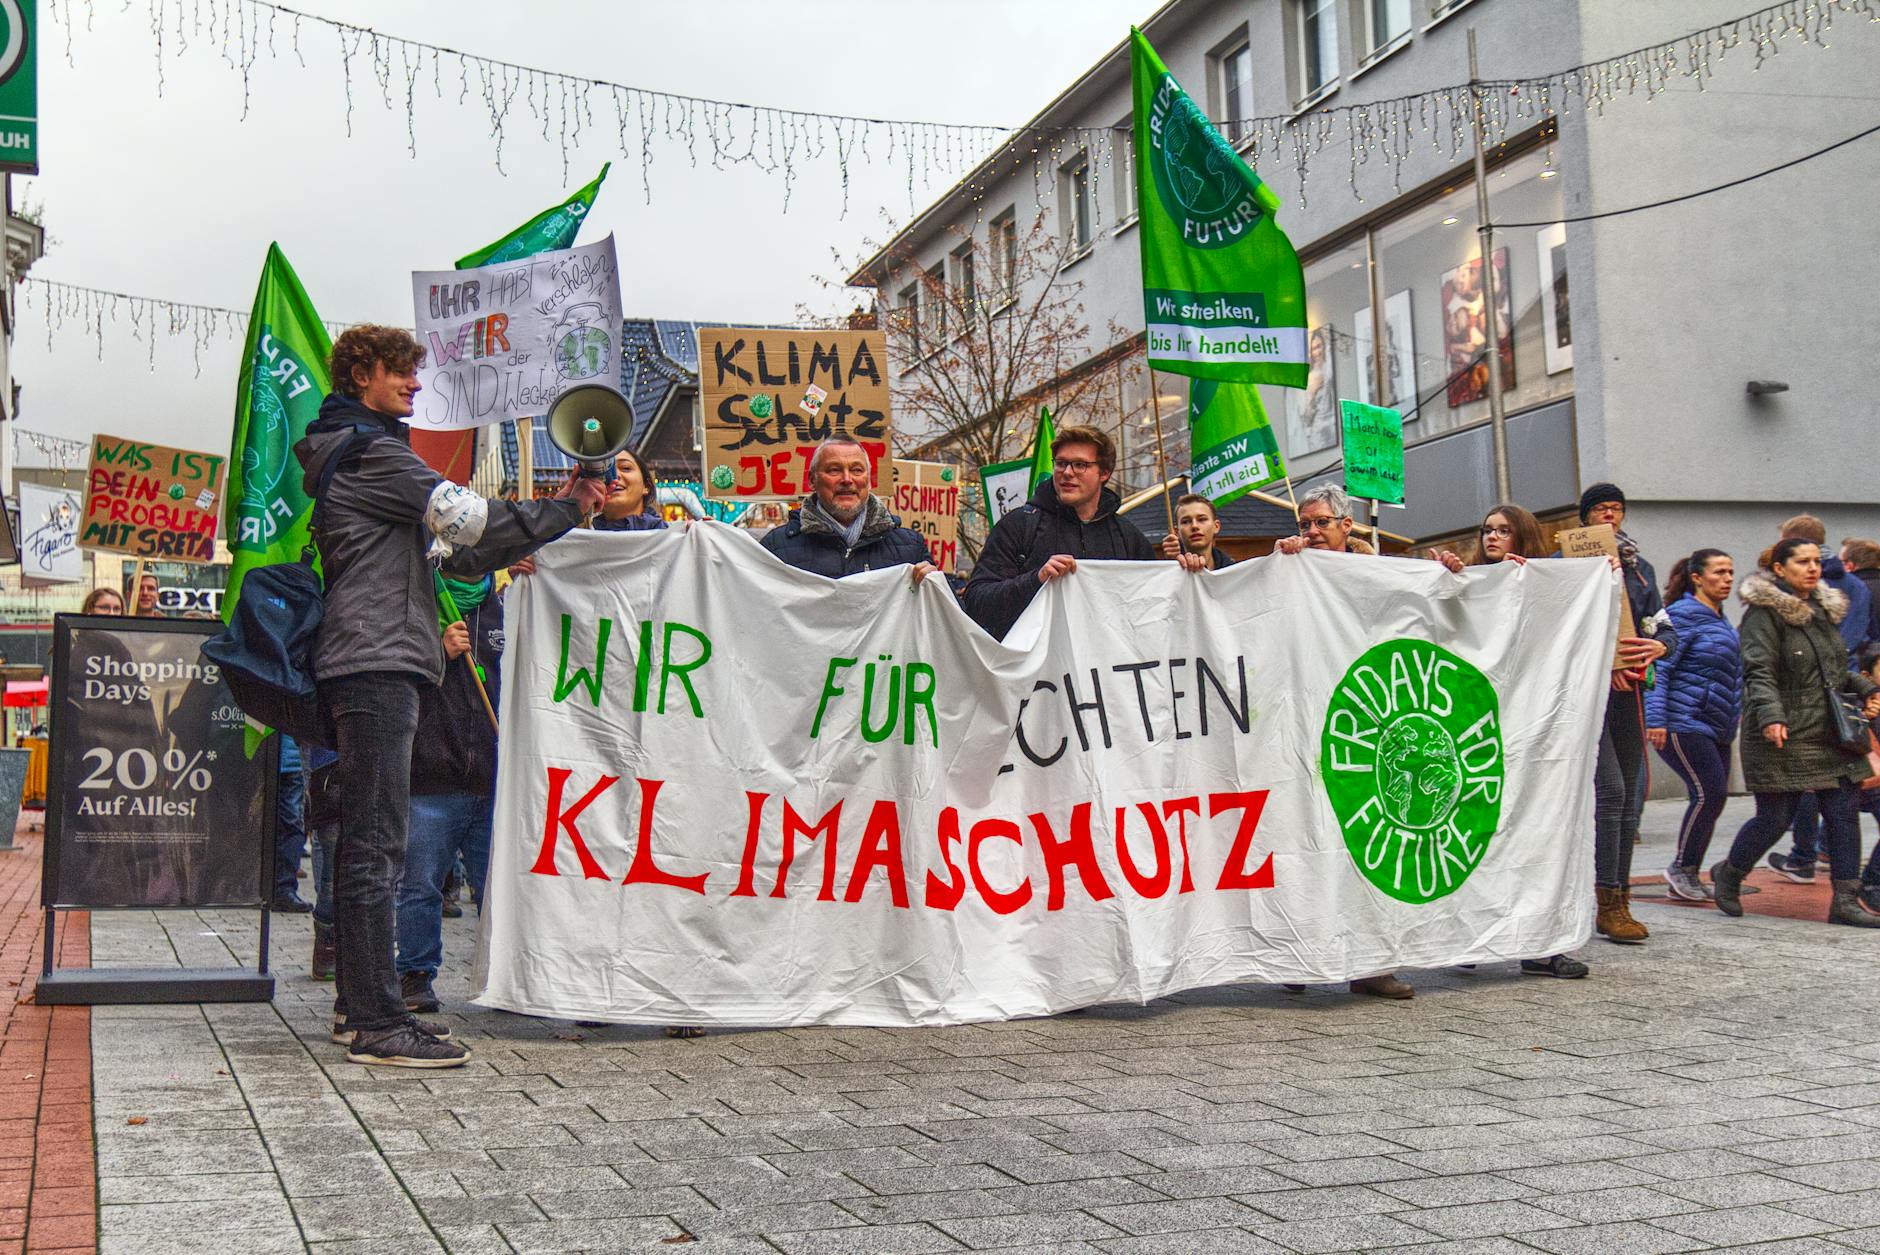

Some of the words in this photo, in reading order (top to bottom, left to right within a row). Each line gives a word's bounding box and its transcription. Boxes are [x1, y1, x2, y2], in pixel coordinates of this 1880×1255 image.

[1183, 191, 1260, 244] FUTUR
[429, 280, 481, 319] IHR
[486, 260, 551, 308] HABT
[536, 253, 610, 316] verschlafen
[507, 349, 532, 367] der
[714, 338, 882, 391] KLIMA
[1151, 331, 1172, 351] bis
[1199, 334, 1280, 355] handelt!
[425, 364, 499, 425] SIND
[717, 391, 886, 452] Schutz
[91, 468, 161, 502] DEIN
[96, 441, 153, 472] WAS
[171, 452, 224, 488] IST
[82, 521, 136, 546] MIT
[89, 495, 218, 538] PROBLEM
[911, 515, 940, 536] ein
[25, 522, 78, 572] Figaro
[85, 655, 220, 684] Shopping
[85, 679, 151, 705] Days
[553, 613, 712, 718] WIR
[810, 654, 938, 749] FÜR
[1330, 649, 1457, 773] FRIDAYS
[1456, 710, 1502, 804] FOR
[77, 795, 128, 817] Auf
[128, 796, 197, 818] Alles!
[529, 766, 1275, 916] KLIMASCHUTZ
[1344, 794, 1484, 897] FUTURE
